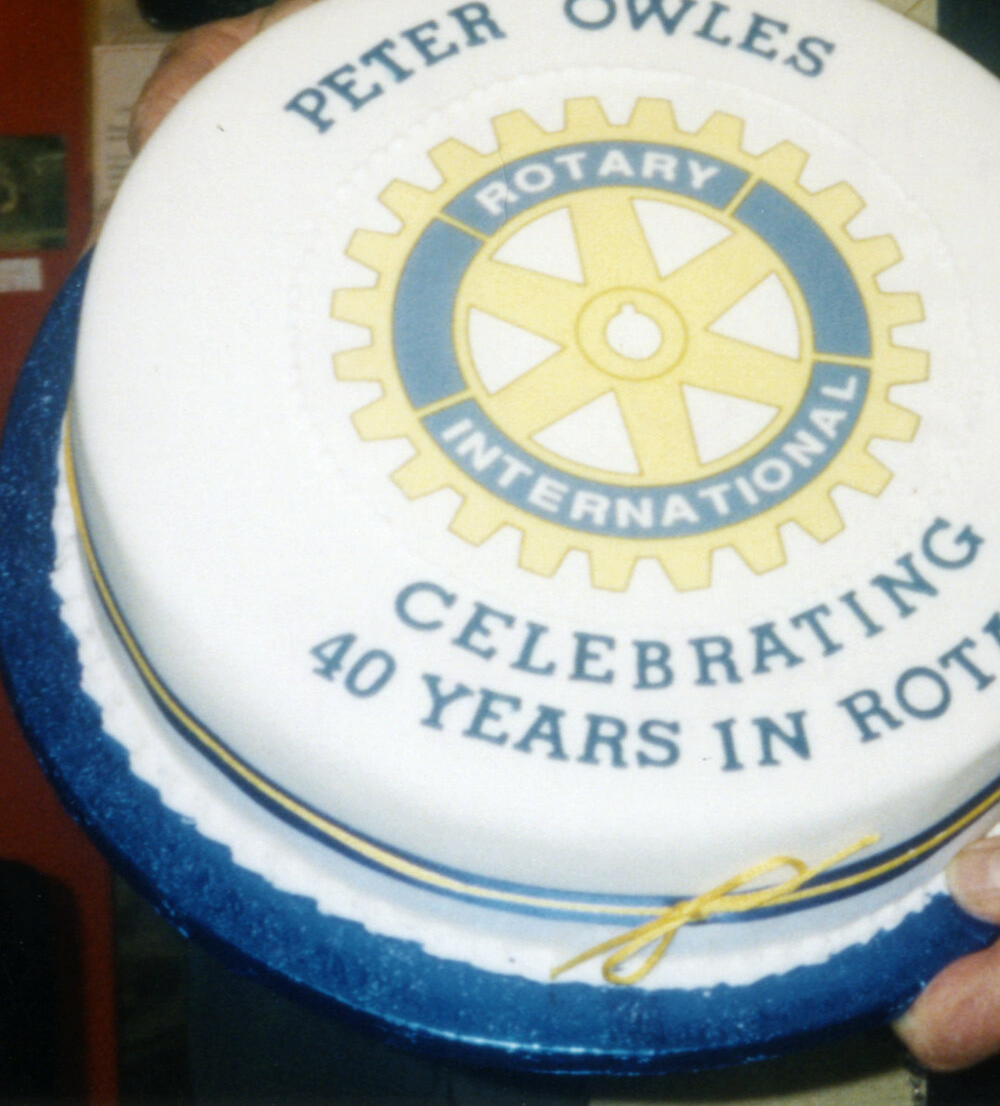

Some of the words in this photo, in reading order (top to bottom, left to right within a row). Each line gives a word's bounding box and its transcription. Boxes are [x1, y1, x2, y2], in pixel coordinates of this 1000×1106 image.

[284, 0, 507, 134] PETER
[474, 150, 721, 216] ROTARY
[440, 375, 858, 529] INTERNATIONAL
[394, 517, 985, 691] CELEBRATING
[310, 632, 397, 699] 40
[420, 674, 682, 769] YEARS
[712, 709, 811, 772] IN
